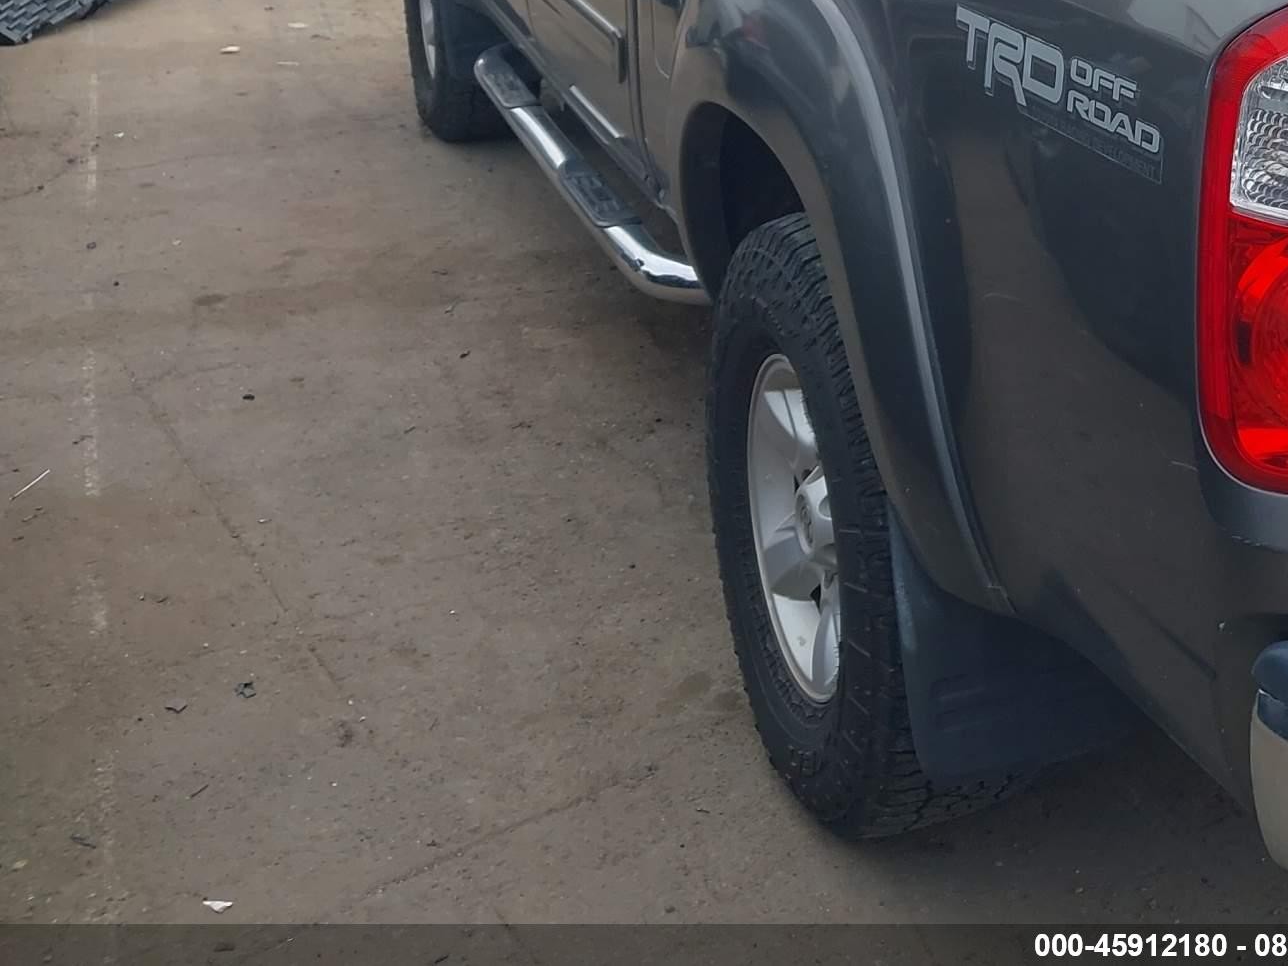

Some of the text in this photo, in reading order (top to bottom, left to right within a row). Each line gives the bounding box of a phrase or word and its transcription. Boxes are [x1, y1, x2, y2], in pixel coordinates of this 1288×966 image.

[955, 3, 1065, 107] TRD
[1070, 57, 1138, 101] OFF
[1066, 90, 1161, 154] ROAD
